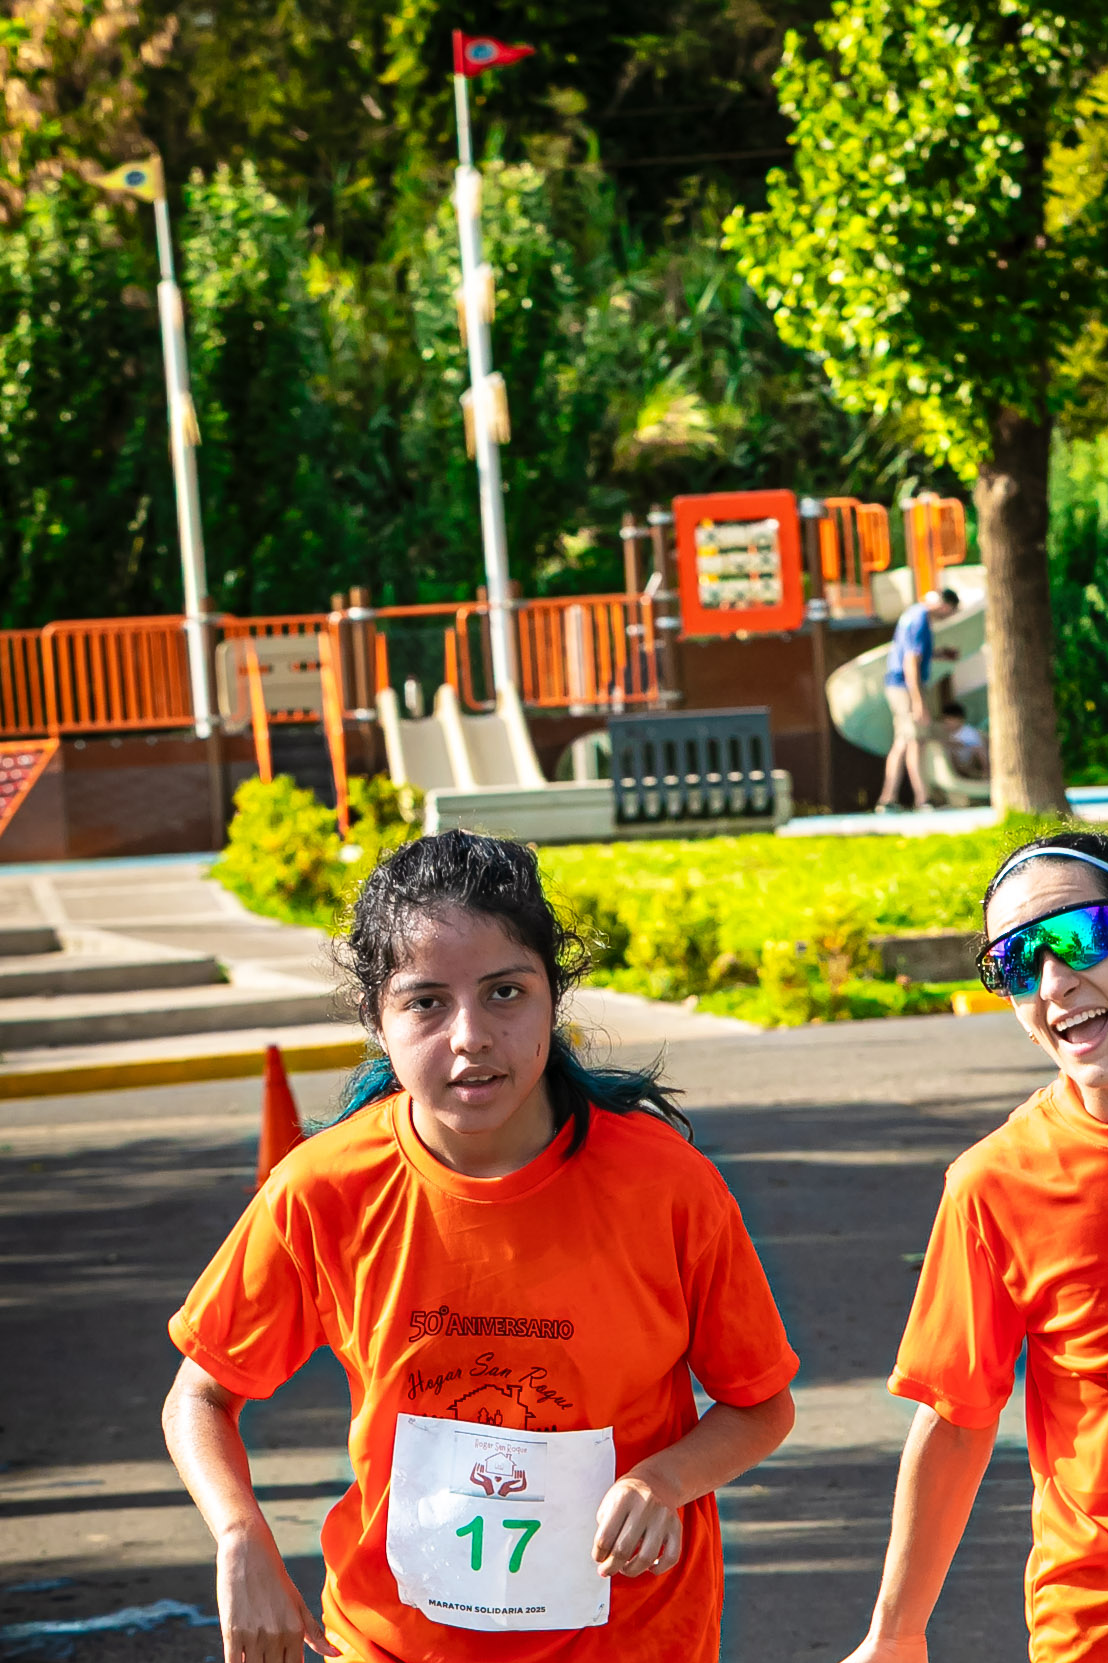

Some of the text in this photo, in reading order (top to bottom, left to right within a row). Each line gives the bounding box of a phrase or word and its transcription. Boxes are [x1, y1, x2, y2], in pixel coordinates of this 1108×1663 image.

[407, 1352, 574, 1410] Hogar San Roque
[456, 1515, 541, 1573] 17
[428, 1599, 546, 1614] MARATON SOLIDARIA 2025
